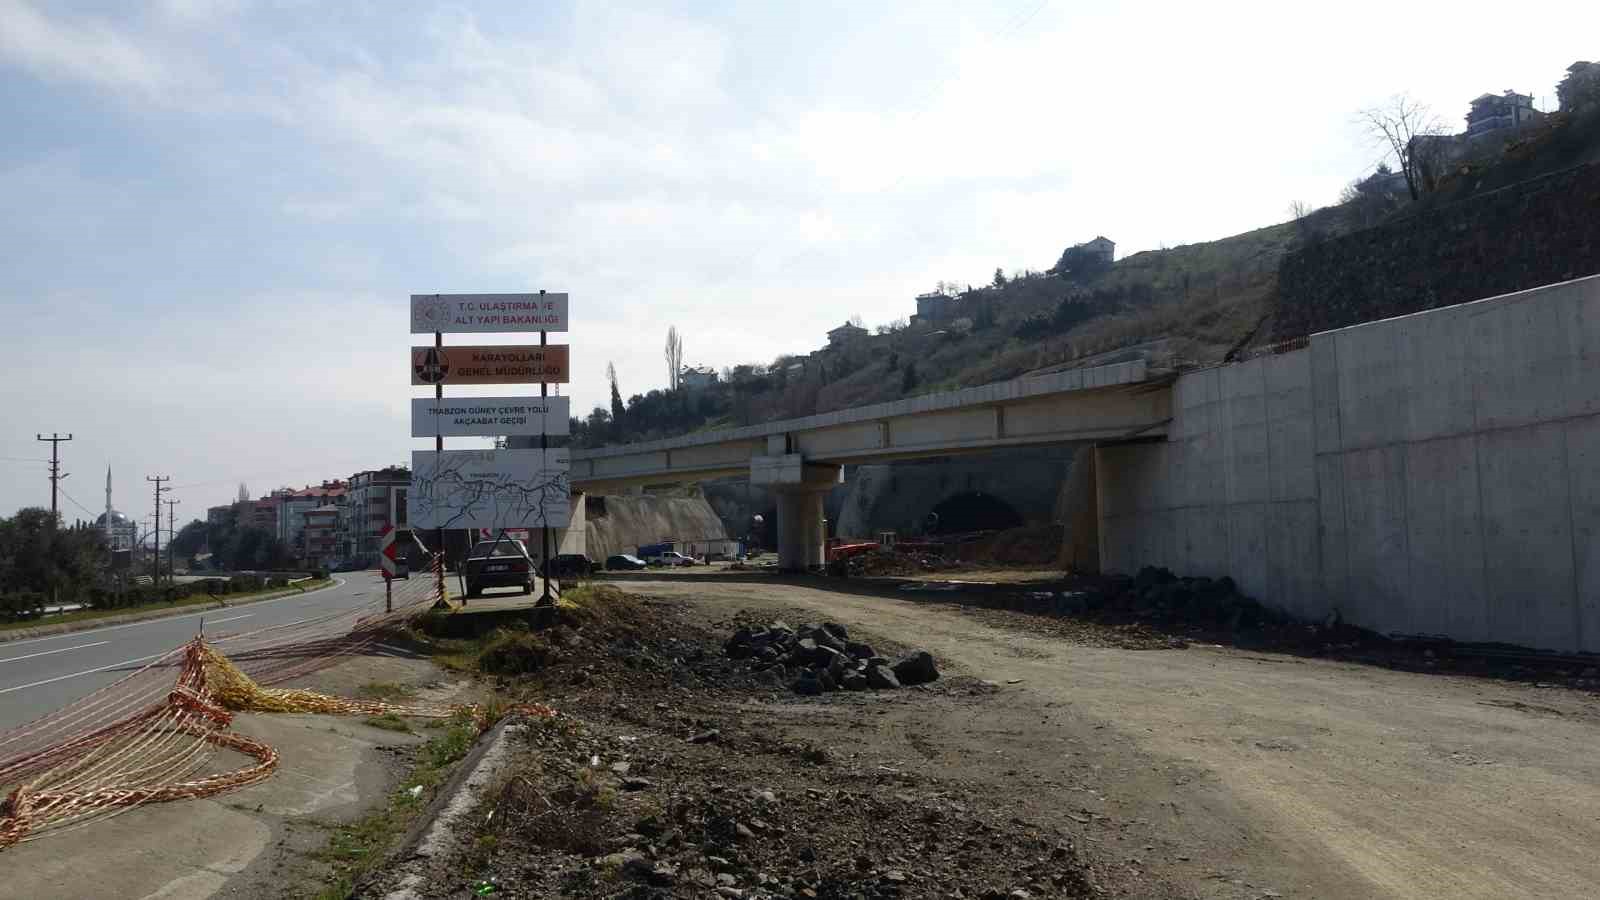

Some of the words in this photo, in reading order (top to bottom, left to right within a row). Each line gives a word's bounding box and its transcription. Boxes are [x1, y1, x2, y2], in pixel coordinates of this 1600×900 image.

[455, 316, 473, 325] ALT
[478, 315, 500, 324] YAPI
[472, 352, 545, 362] KARAYOLLARI
[457, 367, 492, 377] GENEL
[427, 407, 467, 416] TRABZON
[527, 406, 549, 414] YOLU
